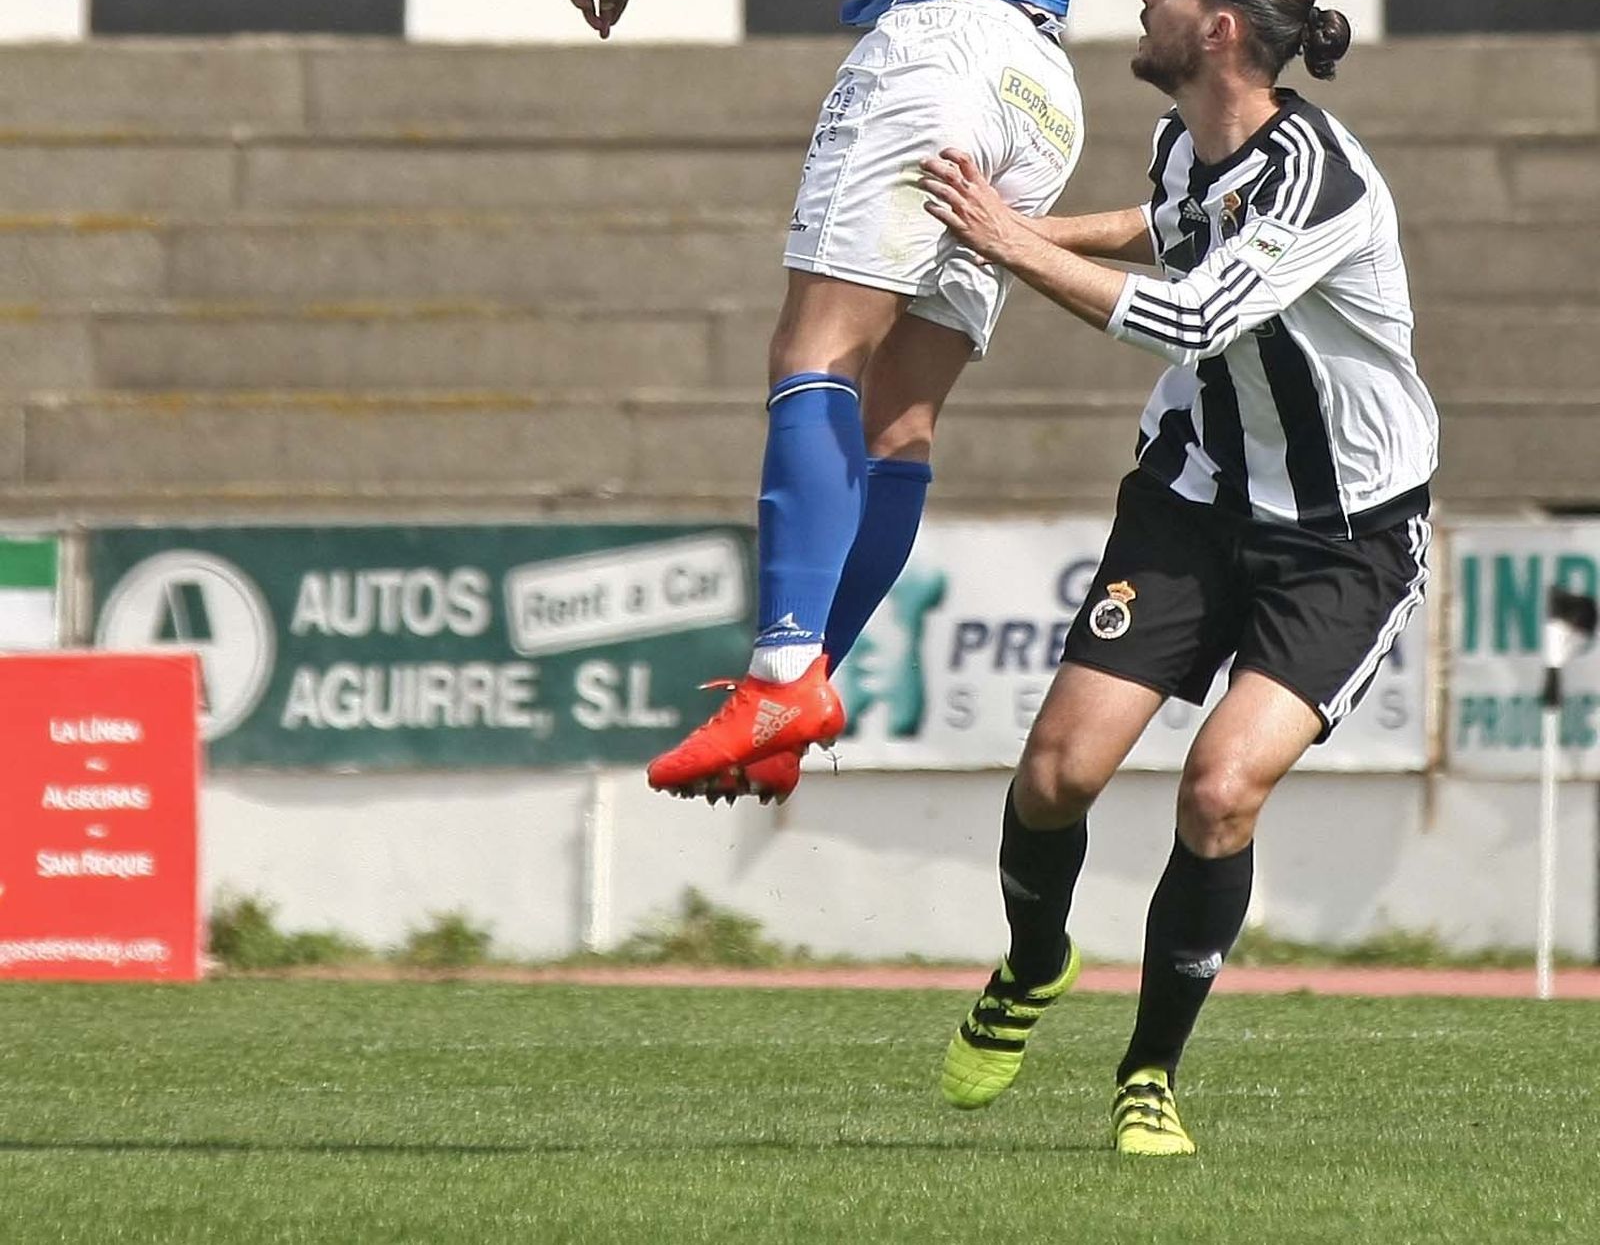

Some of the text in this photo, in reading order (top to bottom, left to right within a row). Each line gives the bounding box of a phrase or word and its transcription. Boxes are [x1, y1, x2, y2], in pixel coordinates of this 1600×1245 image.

[290, 567, 493, 637] AUTOS
[522, 563, 725, 632] Rent a Car
[280, 660, 680, 737] AGUIRRE, S.L.
[752, 706, 802, 749] adidas
